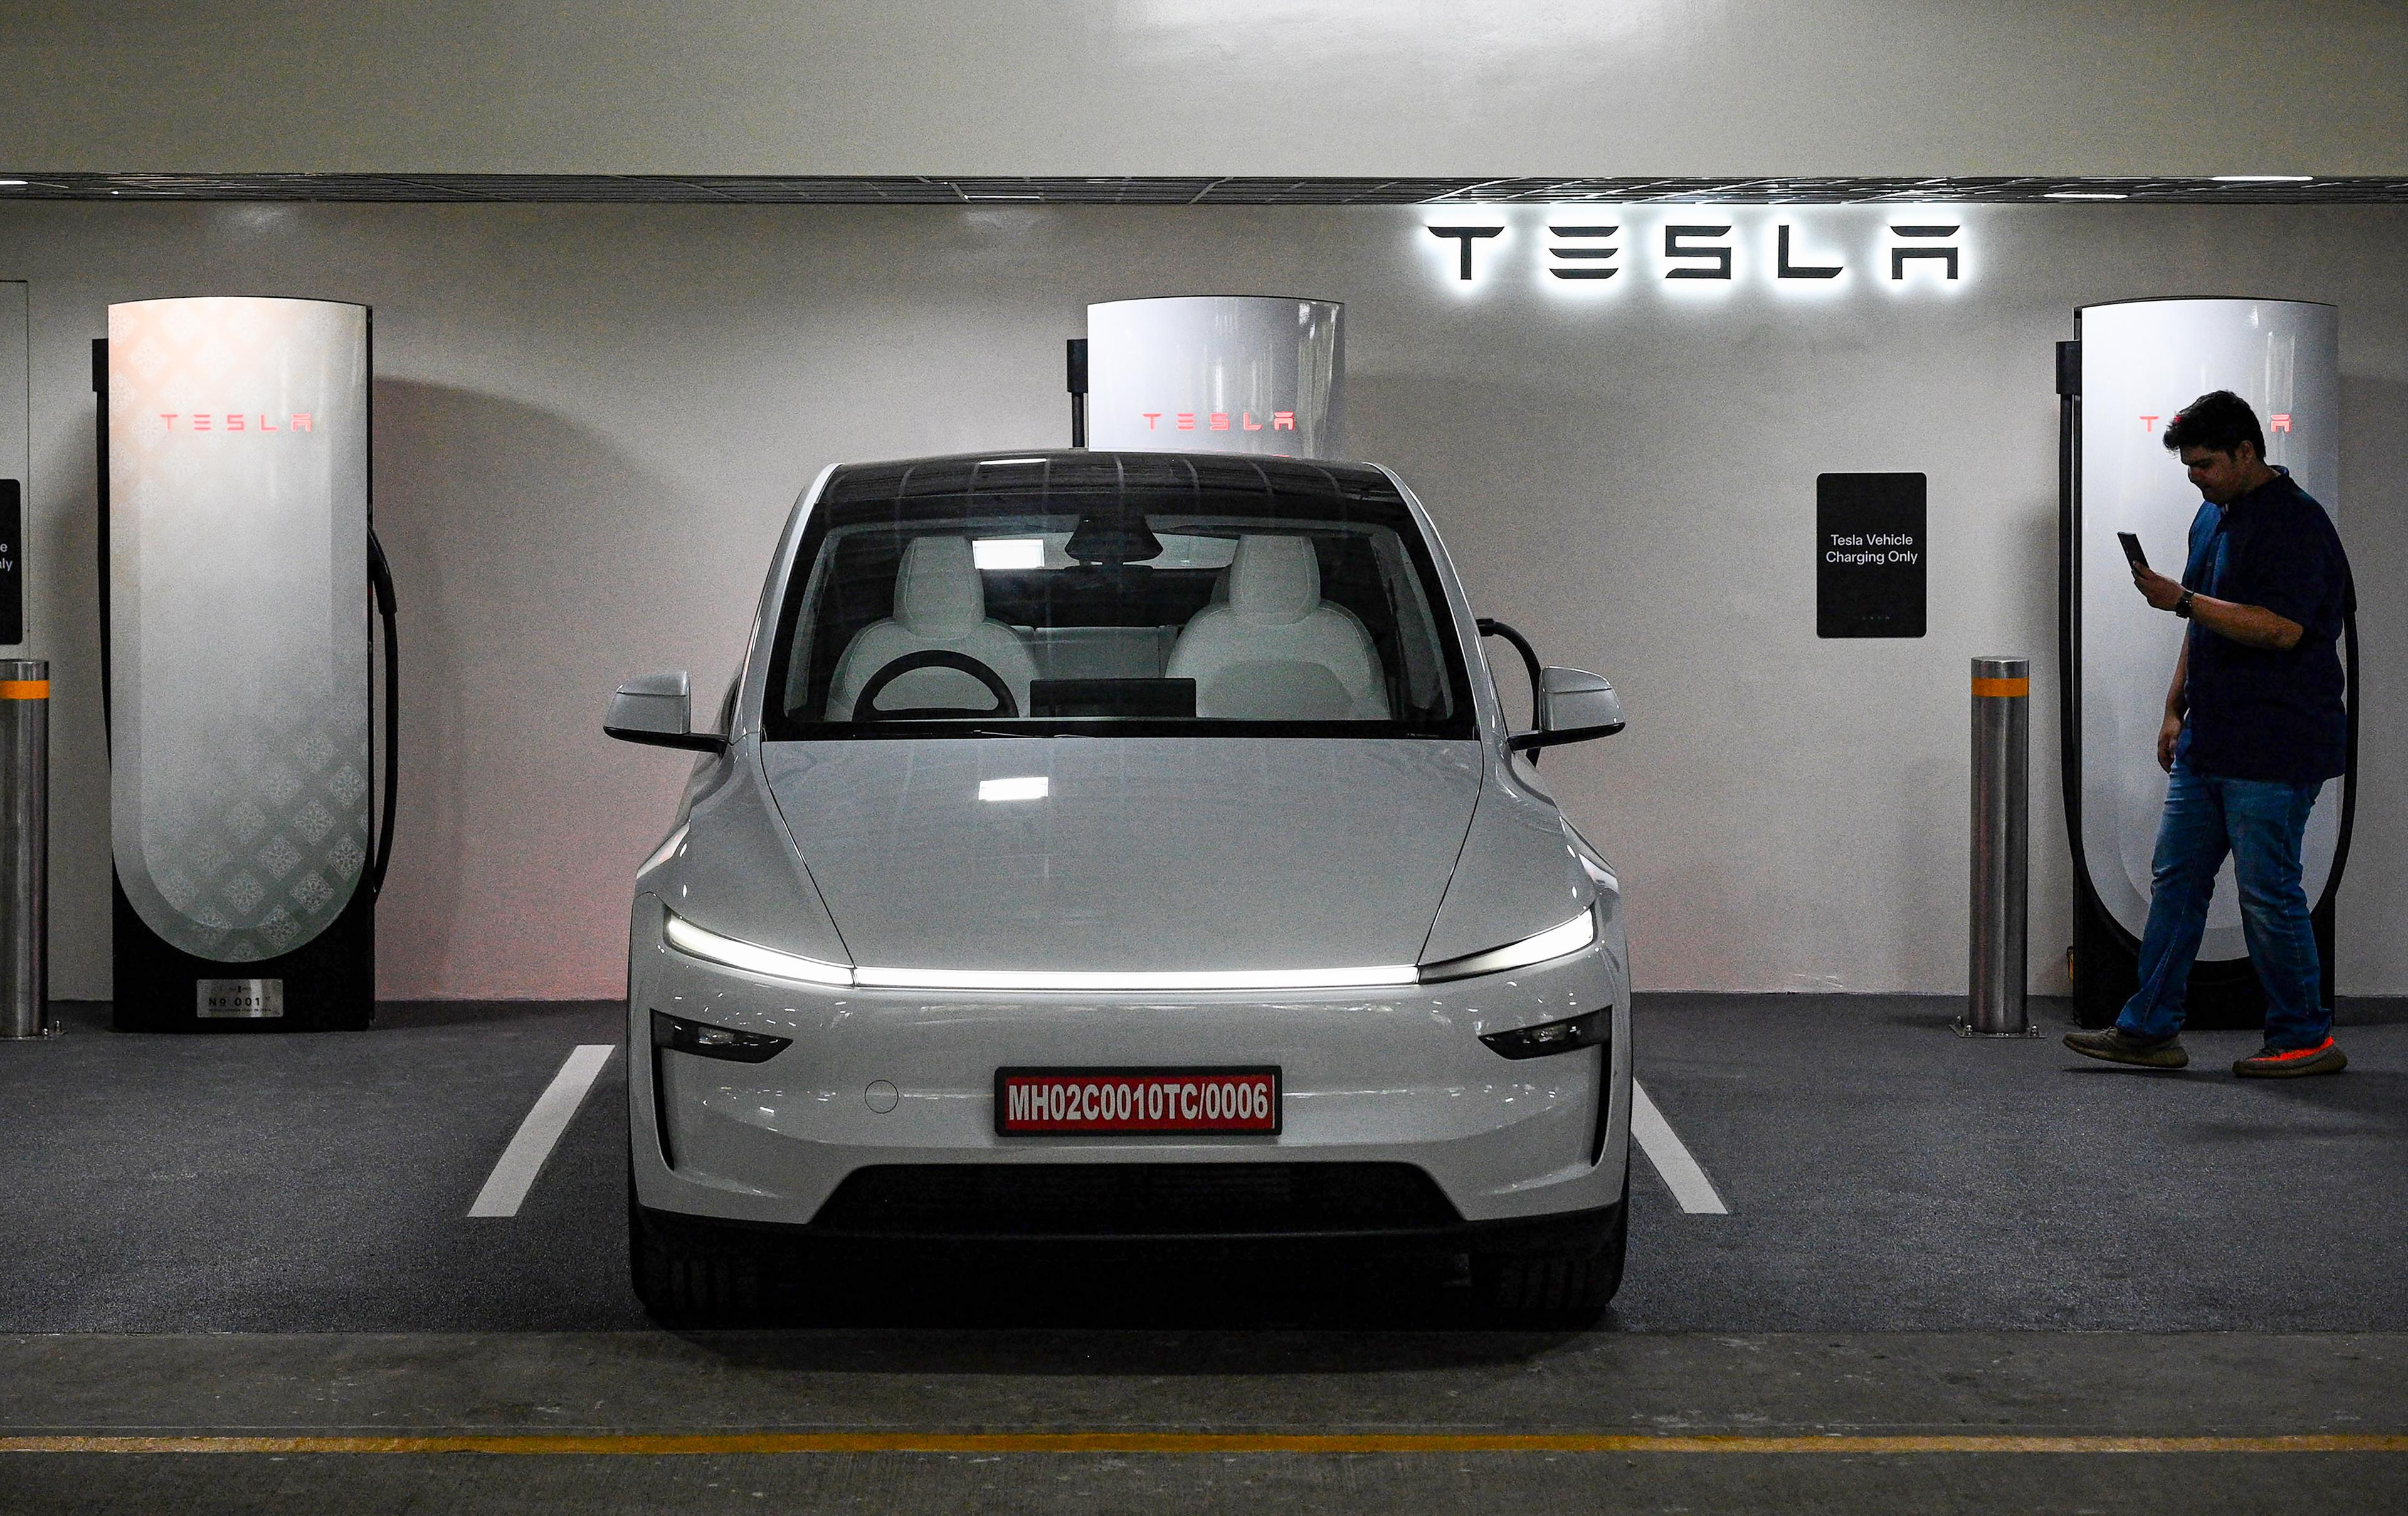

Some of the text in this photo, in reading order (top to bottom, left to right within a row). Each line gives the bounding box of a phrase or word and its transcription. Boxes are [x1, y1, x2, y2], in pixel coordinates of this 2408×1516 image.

[1426, 224, 1960, 280] TESLA
[159, 413, 313, 432] TESLA
[1142, 411, 1296, 431] TESLA
[1830, 534, 1913, 546] Tesla Vehicle
[1825, 550, 1918, 566] Charging Only
[235, 998, 260, 1006] 001
[1008, 1082, 1268, 1120] MH02C0010TC/0006
